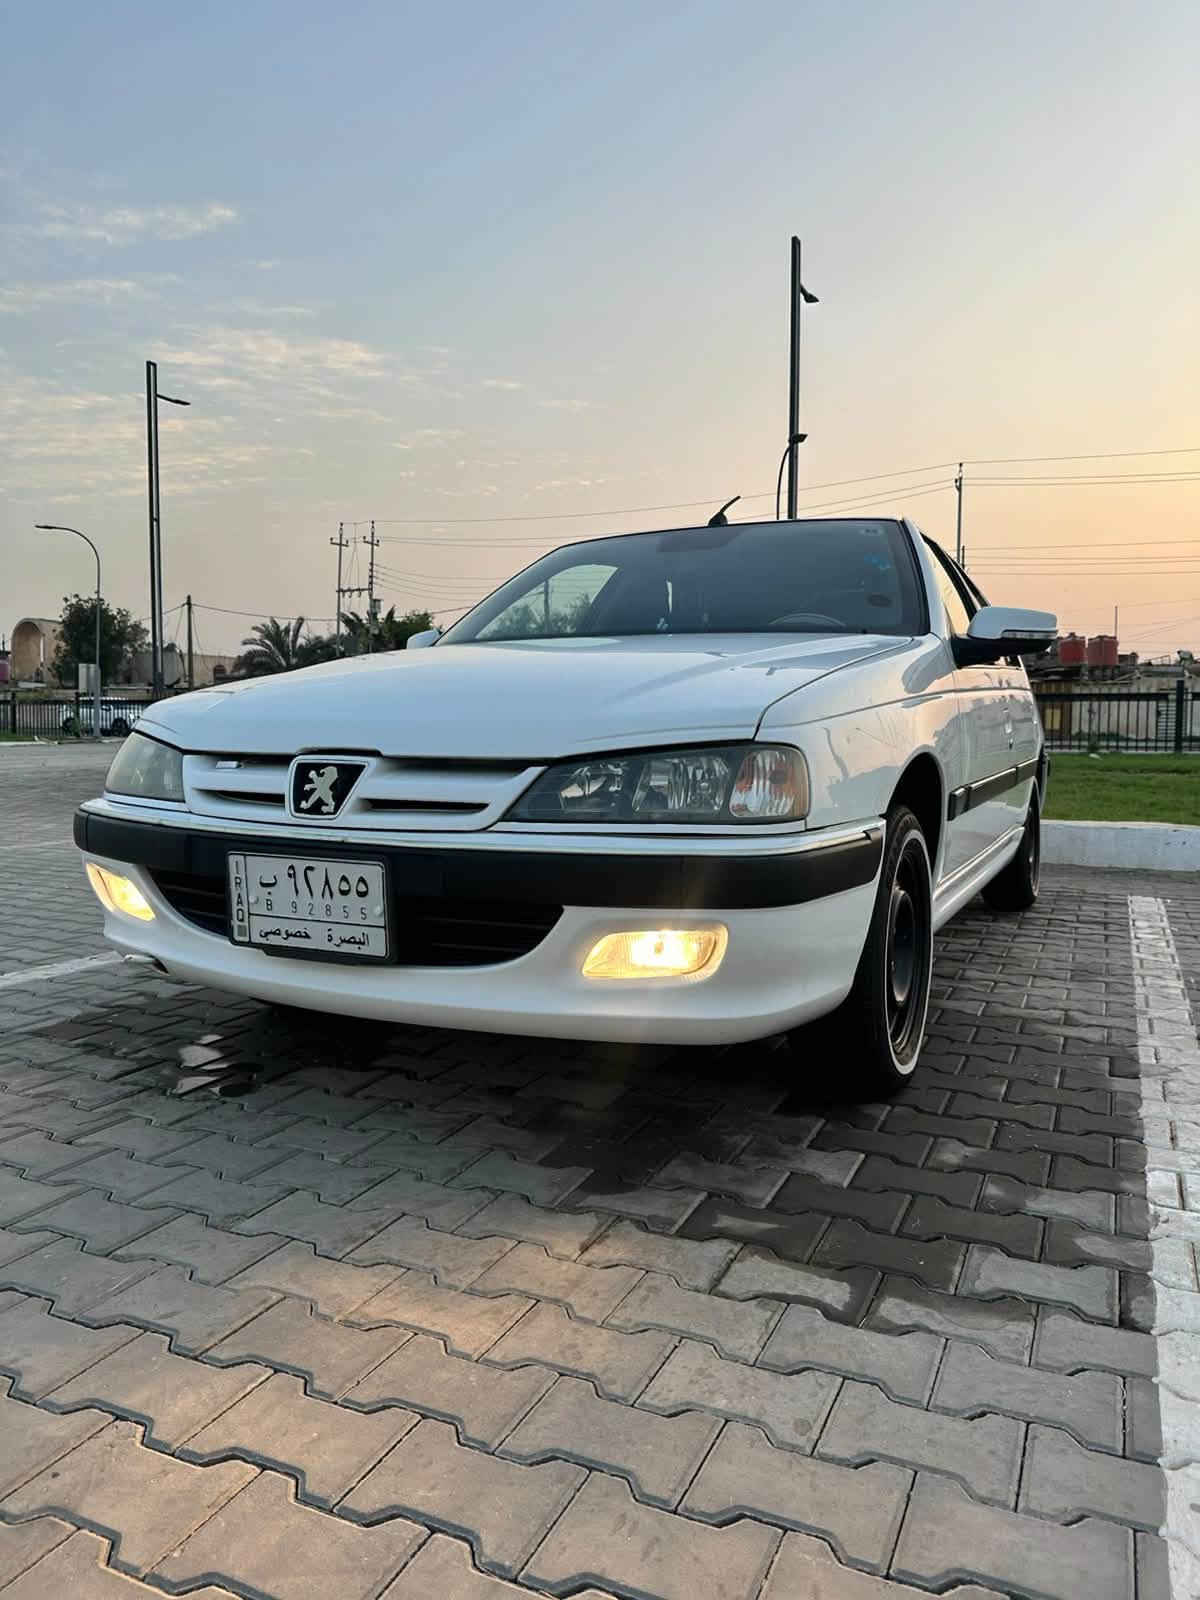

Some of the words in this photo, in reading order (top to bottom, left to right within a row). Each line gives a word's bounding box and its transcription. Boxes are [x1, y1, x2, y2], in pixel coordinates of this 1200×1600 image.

[234, 860, 246, 923] IRAQ
[265, 899, 273, 912] B
[259, 927, 312, 941] خصوصي
[327, 928, 370, 950] البصرة
